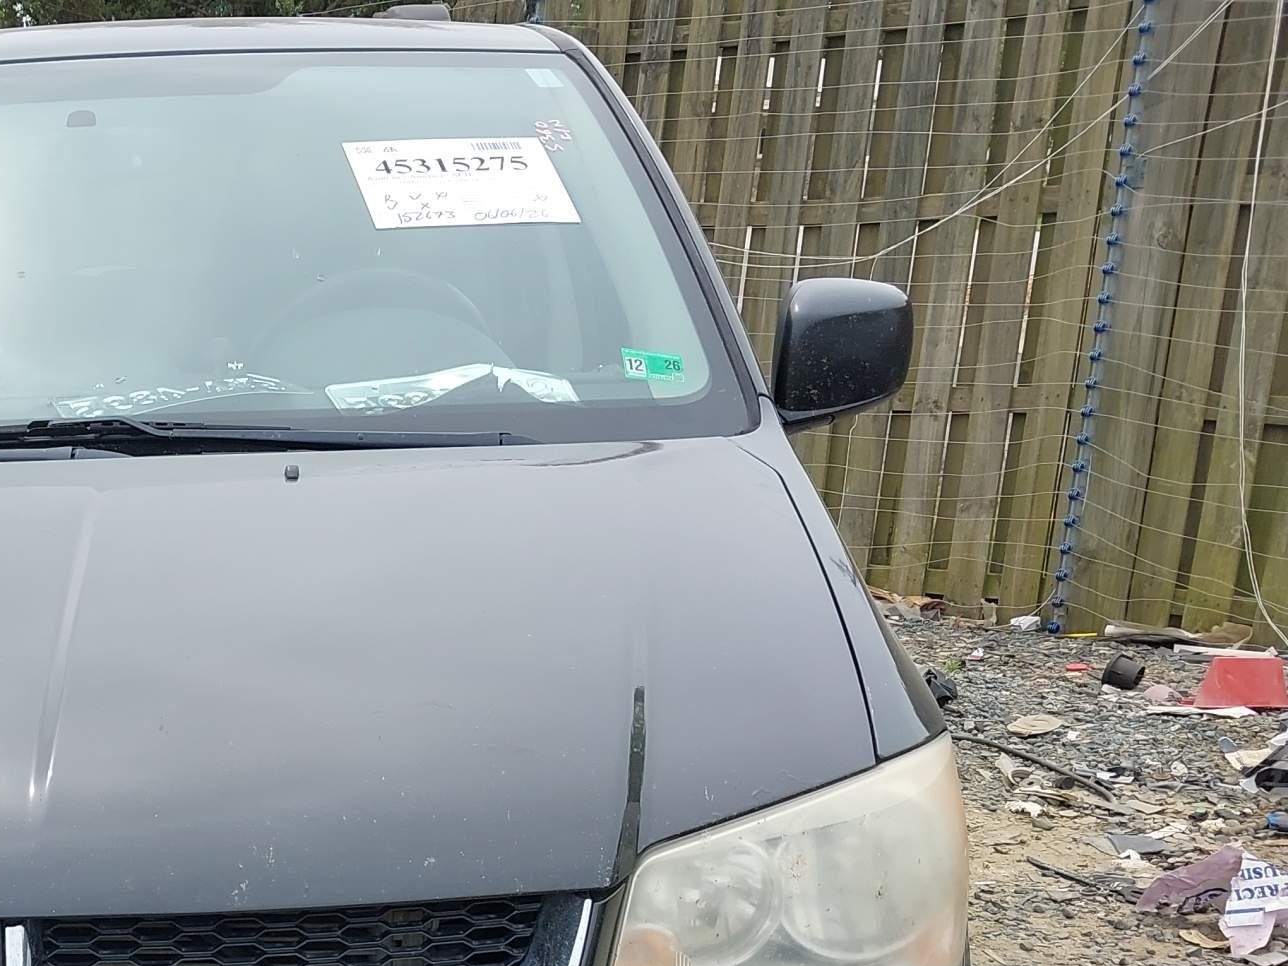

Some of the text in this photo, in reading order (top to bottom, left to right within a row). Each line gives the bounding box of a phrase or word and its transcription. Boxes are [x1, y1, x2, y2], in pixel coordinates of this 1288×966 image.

[375, 156, 529, 175] 45315275
[626, 358, 681, 372] 12 26
